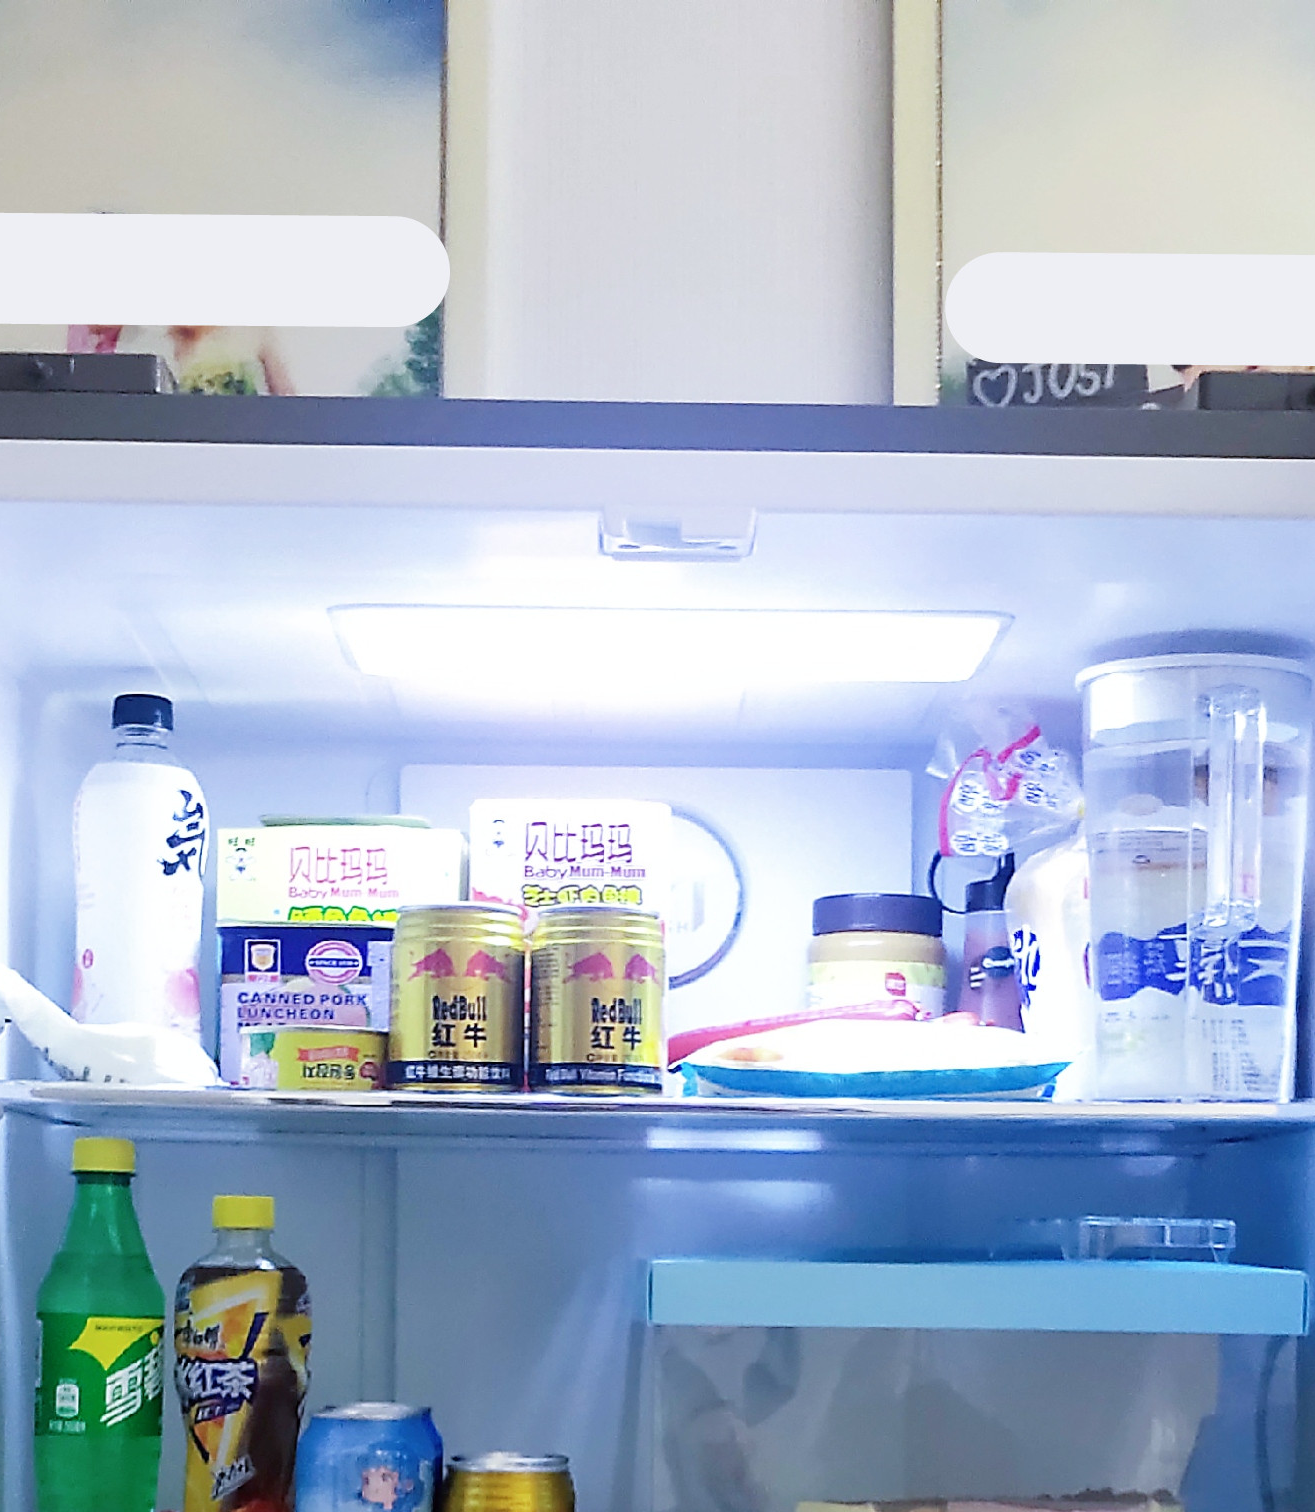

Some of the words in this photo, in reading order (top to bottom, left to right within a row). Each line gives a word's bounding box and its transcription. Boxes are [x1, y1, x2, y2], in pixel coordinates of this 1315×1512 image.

[522, 822, 632, 863] 贝比玛玛
[289, 847, 388, 885] 贝比玛玛
[524, 865, 567, 880] Baby
[288, 886, 327, 899] Baby
[237, 992, 316, 1006] CANNED
[320, 993, 368, 1006] PORK
[237, 1007, 335, 1020] LUNCHEON
[432, 1023, 487, 1048] 红牛
[591, 1026, 642, 1051] 红牛
